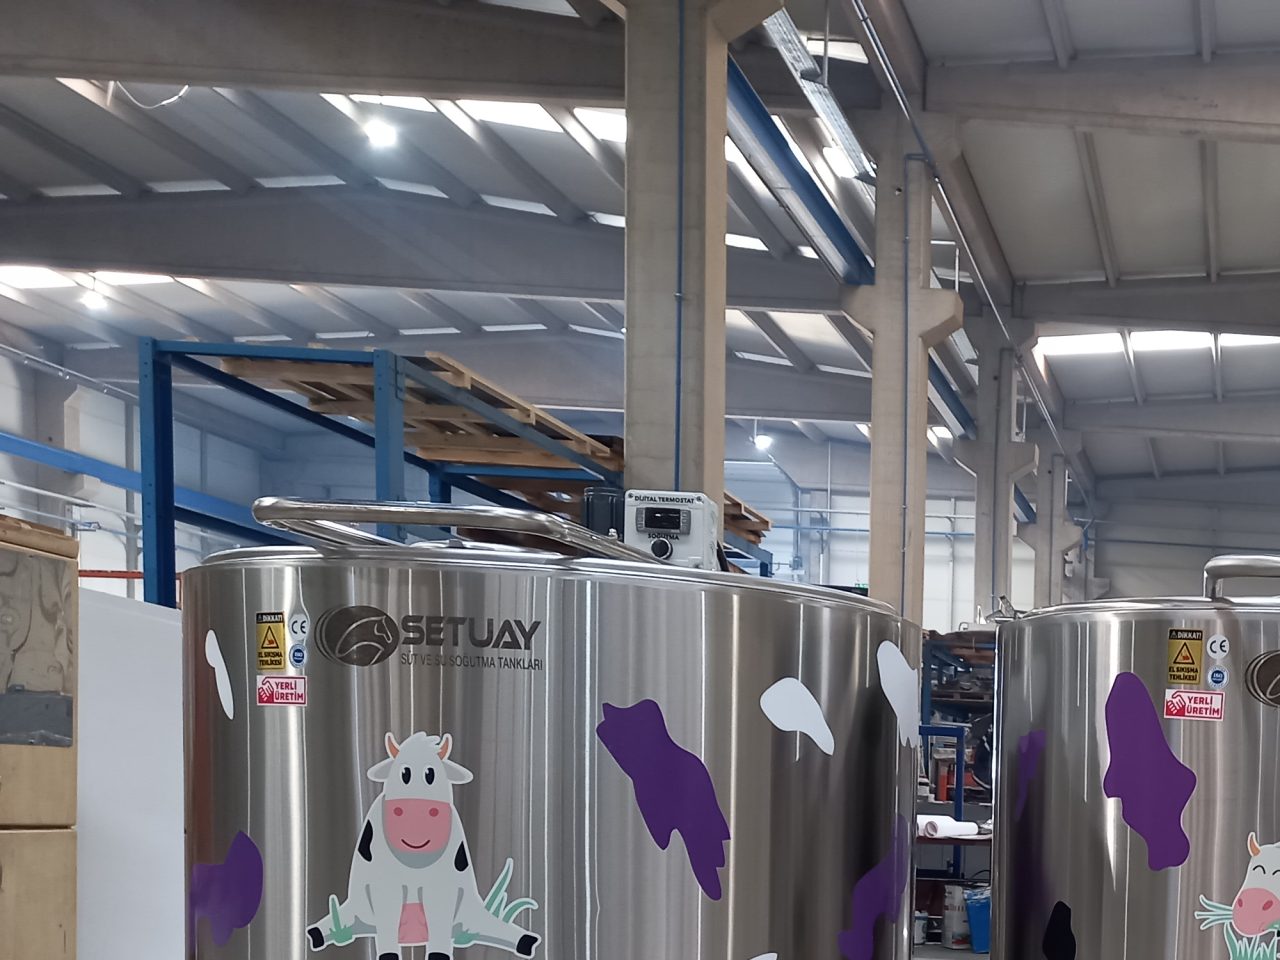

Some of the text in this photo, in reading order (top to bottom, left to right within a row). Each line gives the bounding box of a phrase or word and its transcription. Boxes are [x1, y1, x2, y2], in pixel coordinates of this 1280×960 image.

[658, 496, 694, 504] TERMOSTAT
[291, 620, 306, 635] CE
[401, 615, 542, 651] SETUAY
[1209, 639, 1227, 654] CE
[401, 650, 418, 666] SÜT
[420, 654, 432, 666] VE
[450, 653, 496, 669] SOĞUTMA
[498, 656, 543, 671] TANKLARI
[274, 680, 297, 690] YERLİ
[274, 691, 304, 701] ÜRETİM
[1187, 695, 1213, 705] YERLİ
[1186, 705, 1220, 716] ÜRETİM
